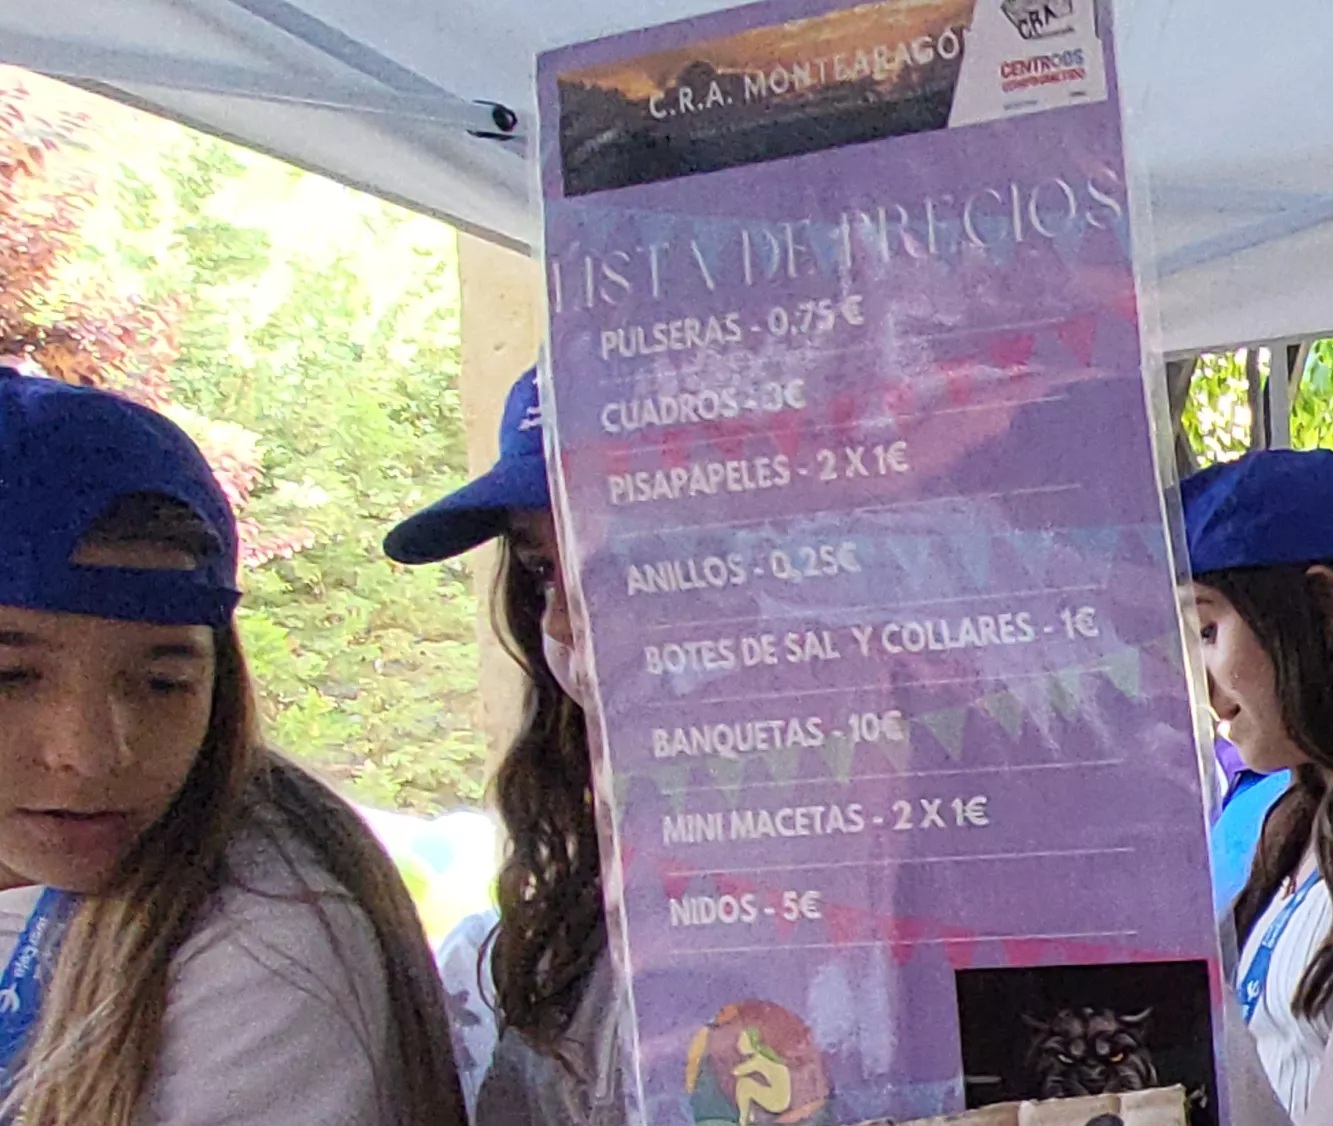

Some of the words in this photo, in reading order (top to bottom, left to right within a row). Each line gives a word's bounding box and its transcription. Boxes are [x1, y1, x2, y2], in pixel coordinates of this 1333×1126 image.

[649, 83, 733, 119] C.R.A.
[553, 238, 717, 314] LISTA
[600, 311, 743, 360] PULSERAS
[600, 386, 739, 434] CUADROS
[607, 453, 792, 506] PISAPAPELES
[815, 448, 838, 481] 2
[873, 440, 909, 475] 1€
[625, 553, 746, 597] ANILLOS
[644, 636, 740, 676] BOTES
[740, 631, 778, 667] DE
[784, 630, 841, 664] SAL
[850, 625, 875, 657] Y
[880, 611, 1036, 655] COLLARES
[1059, 605, 1100, 640] 1€
[652, 717, 826, 761] BANQUETAS
[848, 709, 904, 744] 10€
[661, 811, 725, 847] MINI
[728, 803, 866, 842] MACETAS
[891, 800, 913, 832] 2
[950, 795, 991, 828] 1€
[668, 893, 760, 927] NIDOS
[783, 890, 824, 923] 5€
